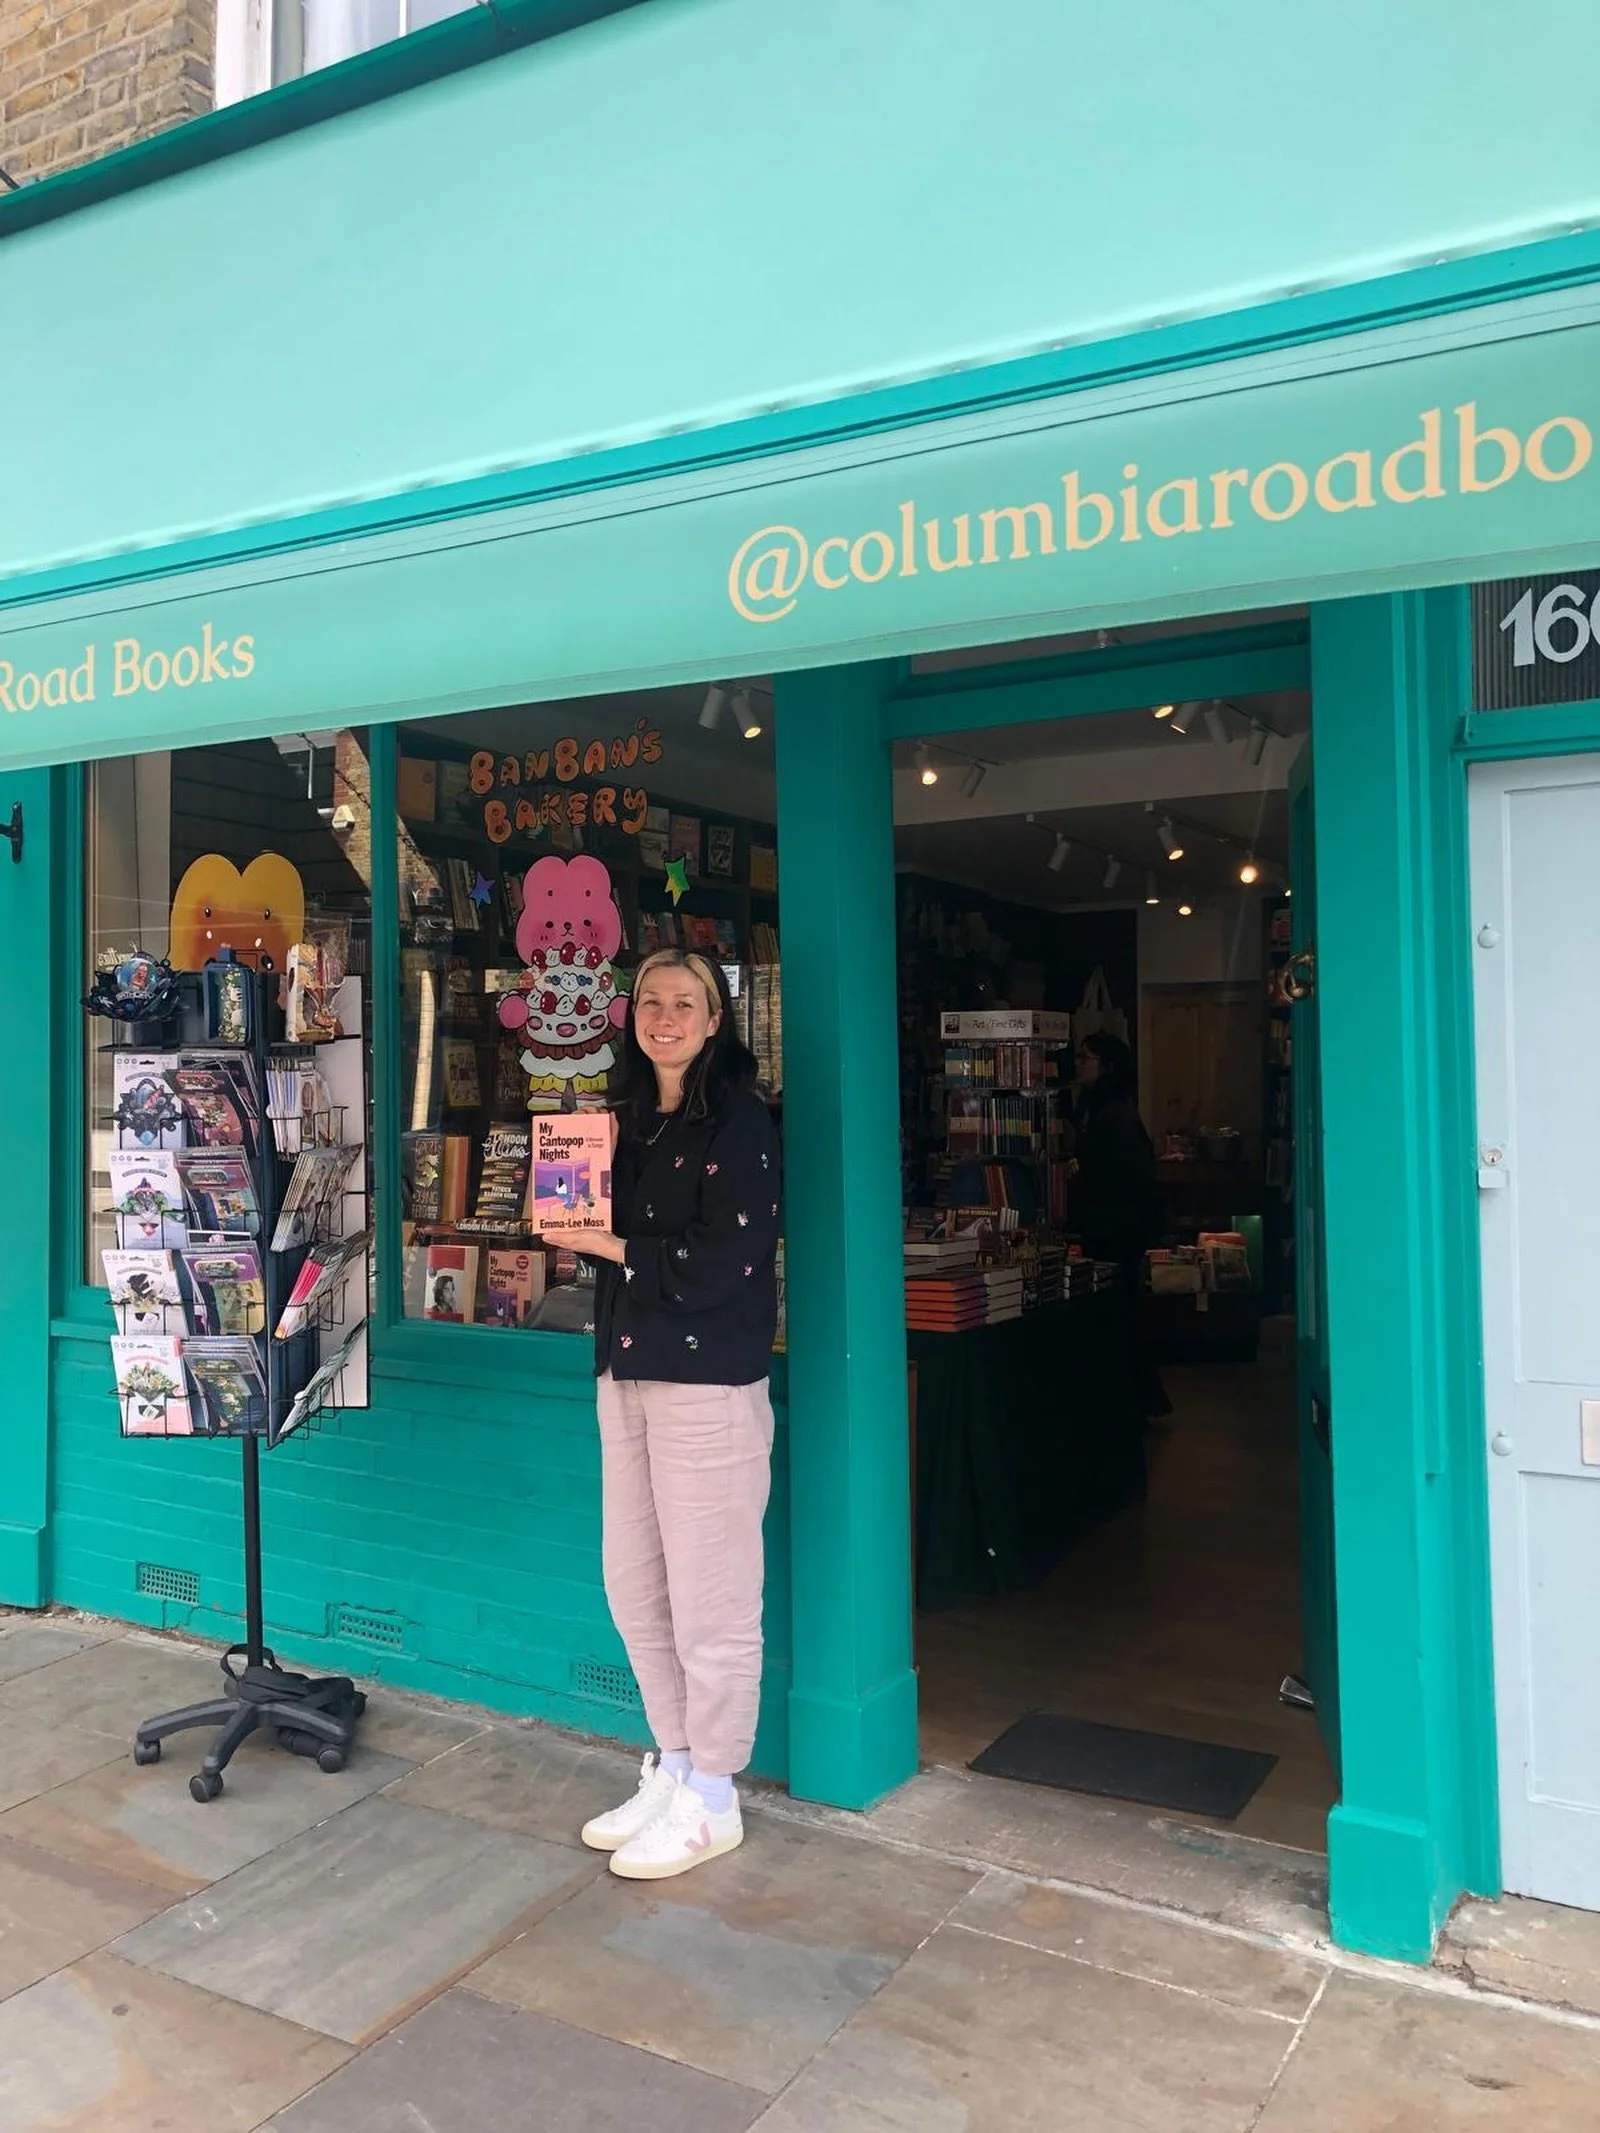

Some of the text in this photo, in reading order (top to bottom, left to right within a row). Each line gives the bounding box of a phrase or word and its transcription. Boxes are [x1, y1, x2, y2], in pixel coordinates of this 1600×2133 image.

[727, 400, 1593, 624] @columbiaroadbo
[1499, 583, 1600, 667] 16
[112, 620, 256, 698] Books
[483, 786, 649, 845] BAKERY
[539, 1122, 553, 1135] My
[493, 1133, 528, 1145] LONDON
[539, 1136, 584, 1148] Cantopop
[539, 1149, 570, 1162] Nights
[539, 1218, 605, 1229] Emma-Lee Moss
